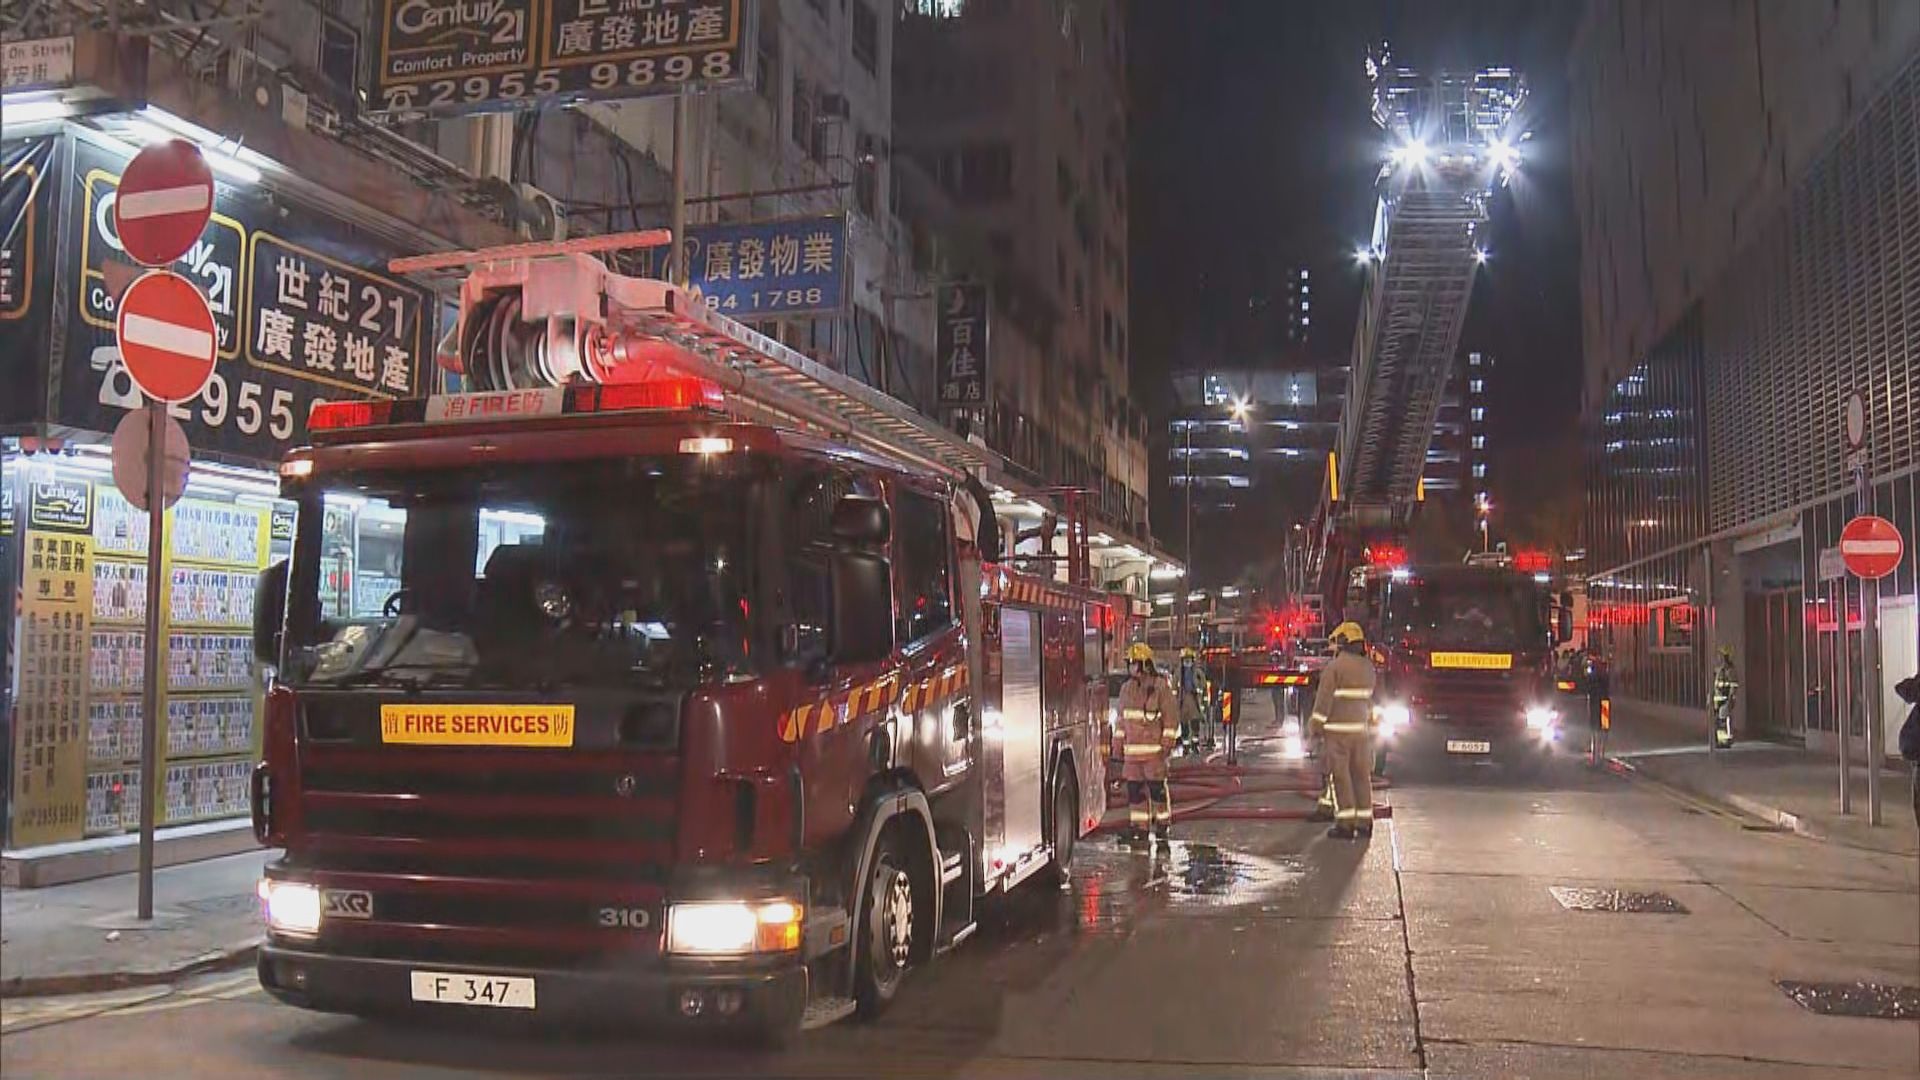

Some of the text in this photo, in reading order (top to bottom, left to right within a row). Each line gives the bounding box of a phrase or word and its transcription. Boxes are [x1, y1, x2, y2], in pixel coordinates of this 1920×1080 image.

[396, 0, 525, 44] Century 21
[557, 6, 723, 55] 廣發地產
[9, 47, 25, 59] On
[393, 48, 525, 73] Comfort Property
[430, 52, 731, 105] 2955 9898
[704, 232, 834, 282] 廣發物業
[201, 261, 232, 315] 21
[276, 256, 404, 339] 世紀21
[751, 288, 822, 308] 1788
[256, 307, 410, 393] 廣發地產
[166, 373, 294, 440] 955
[469, 393, 521, 416] FIRE
[405, 714, 447, 734] FIRE
[451, 715, 550, 735] SERVICES
[599, 907, 650, 928] 310
[435, 978, 510, 1003] F 347
